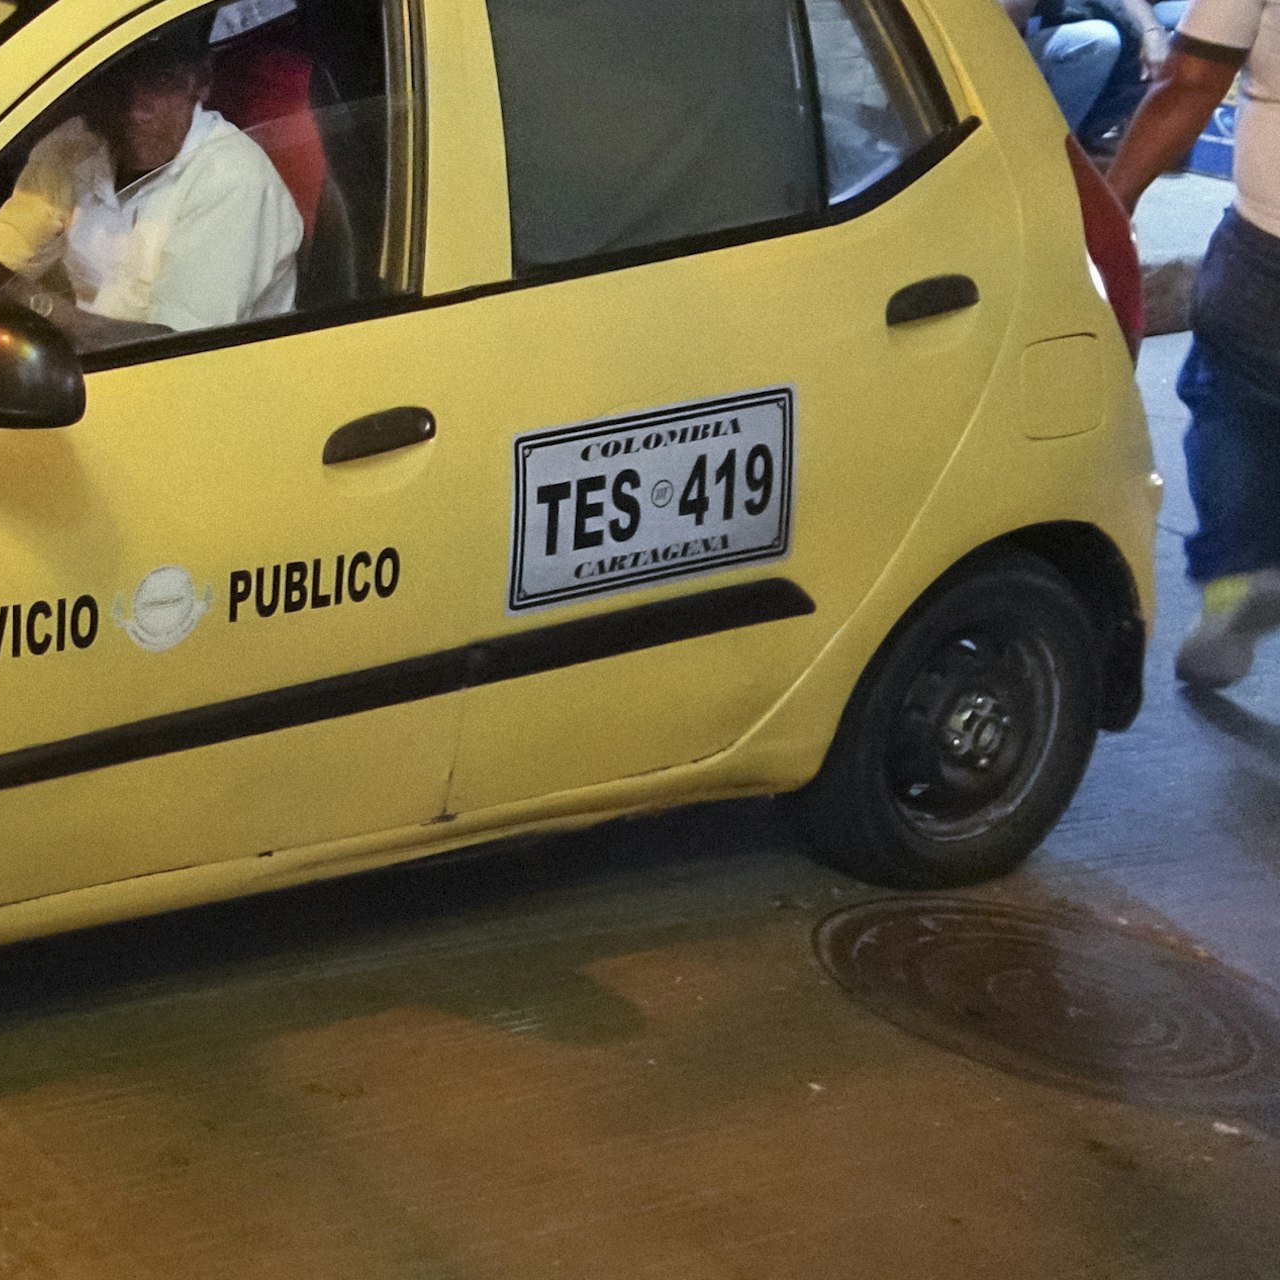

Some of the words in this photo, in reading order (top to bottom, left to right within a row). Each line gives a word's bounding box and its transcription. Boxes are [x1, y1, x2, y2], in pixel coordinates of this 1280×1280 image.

[580, 417, 742, 462] COLOMBIA
[536, 468, 641, 556] TES
[678, 442, 775, 527] 419
[228, 546, 401, 623] PUBLICO
[573, 533, 730, 580] CARTAGENA
